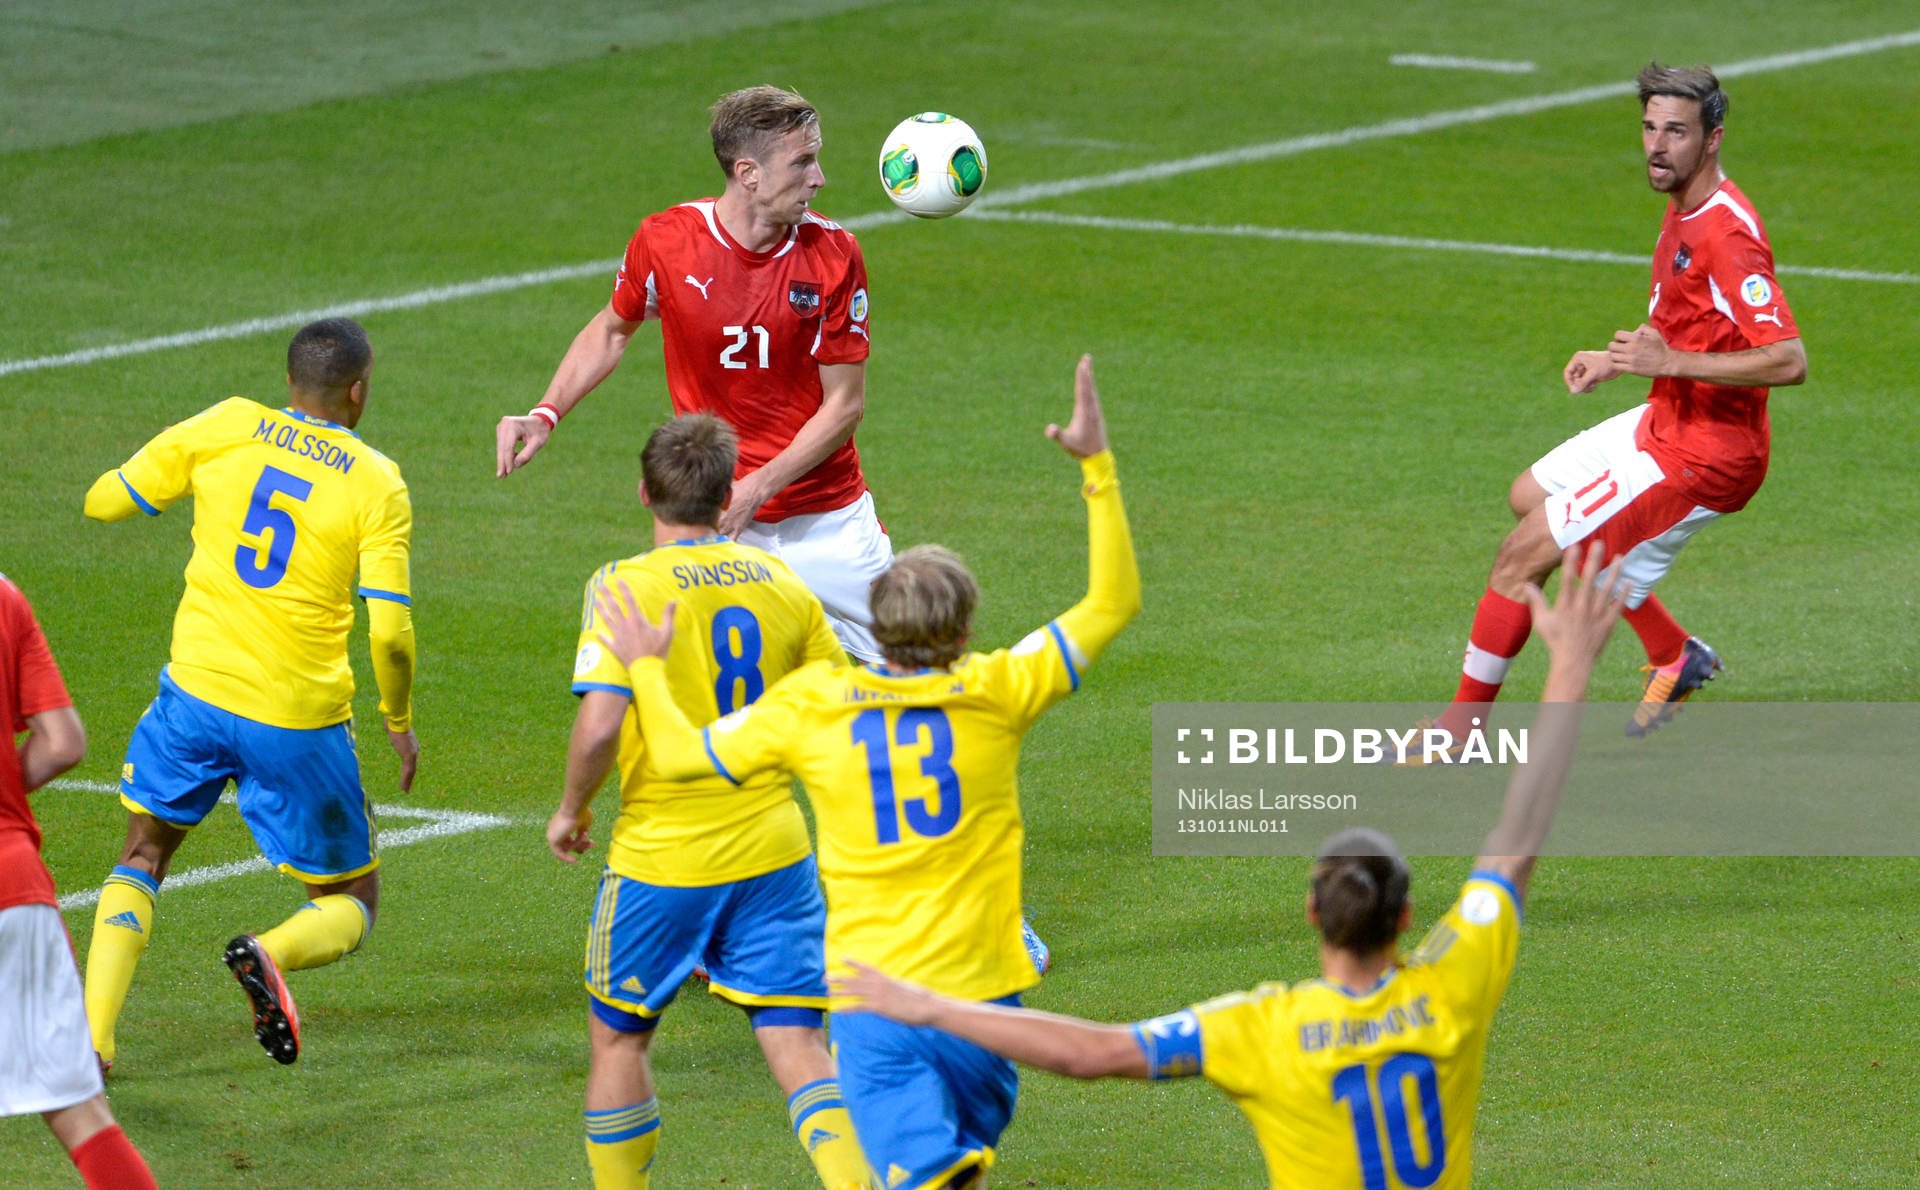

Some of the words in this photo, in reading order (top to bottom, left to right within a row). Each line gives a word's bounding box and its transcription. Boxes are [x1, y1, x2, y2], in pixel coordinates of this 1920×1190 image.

[720, 325, 770, 369] 21
[252, 418, 356, 474] M.OLSSON
[1574, 469, 1618, 518] 11
[234, 464, 314, 589] 5
[712, 605, 765, 718] 8
[851, 707, 962, 845] 13
[1331, 1051, 1447, 1190] 10
